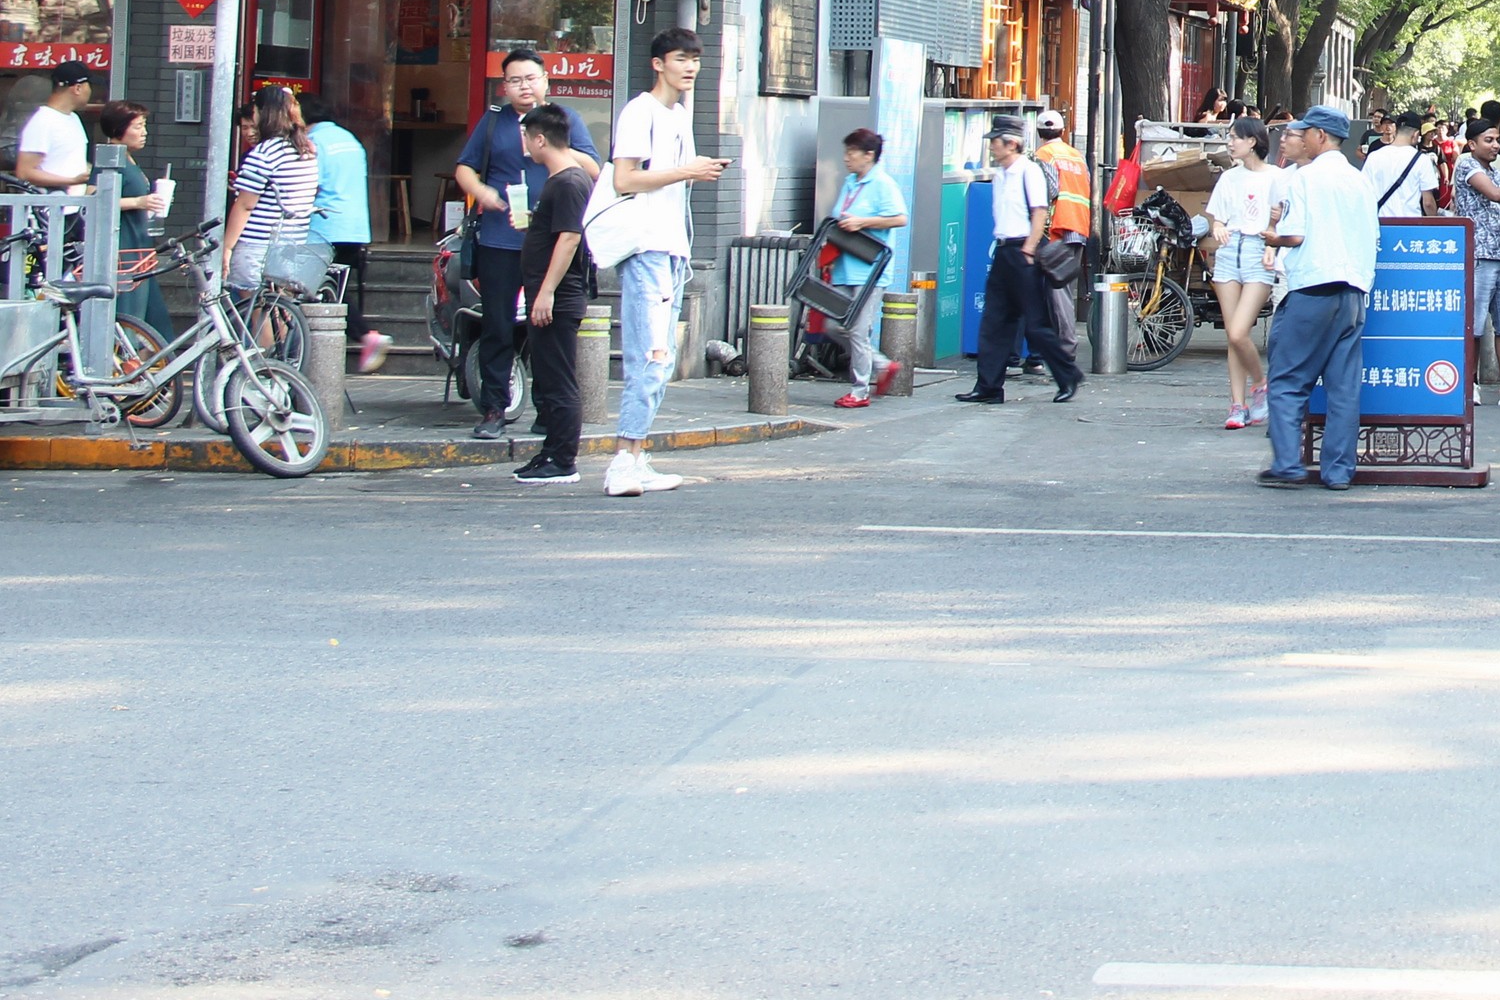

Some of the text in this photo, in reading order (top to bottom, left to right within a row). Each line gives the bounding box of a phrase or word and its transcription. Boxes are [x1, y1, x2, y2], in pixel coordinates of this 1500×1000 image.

[10, 43, 109, 67] 京味小吃
[544, 56, 600, 77] 小吃
[556, 85, 613, 97] SPA Massage
